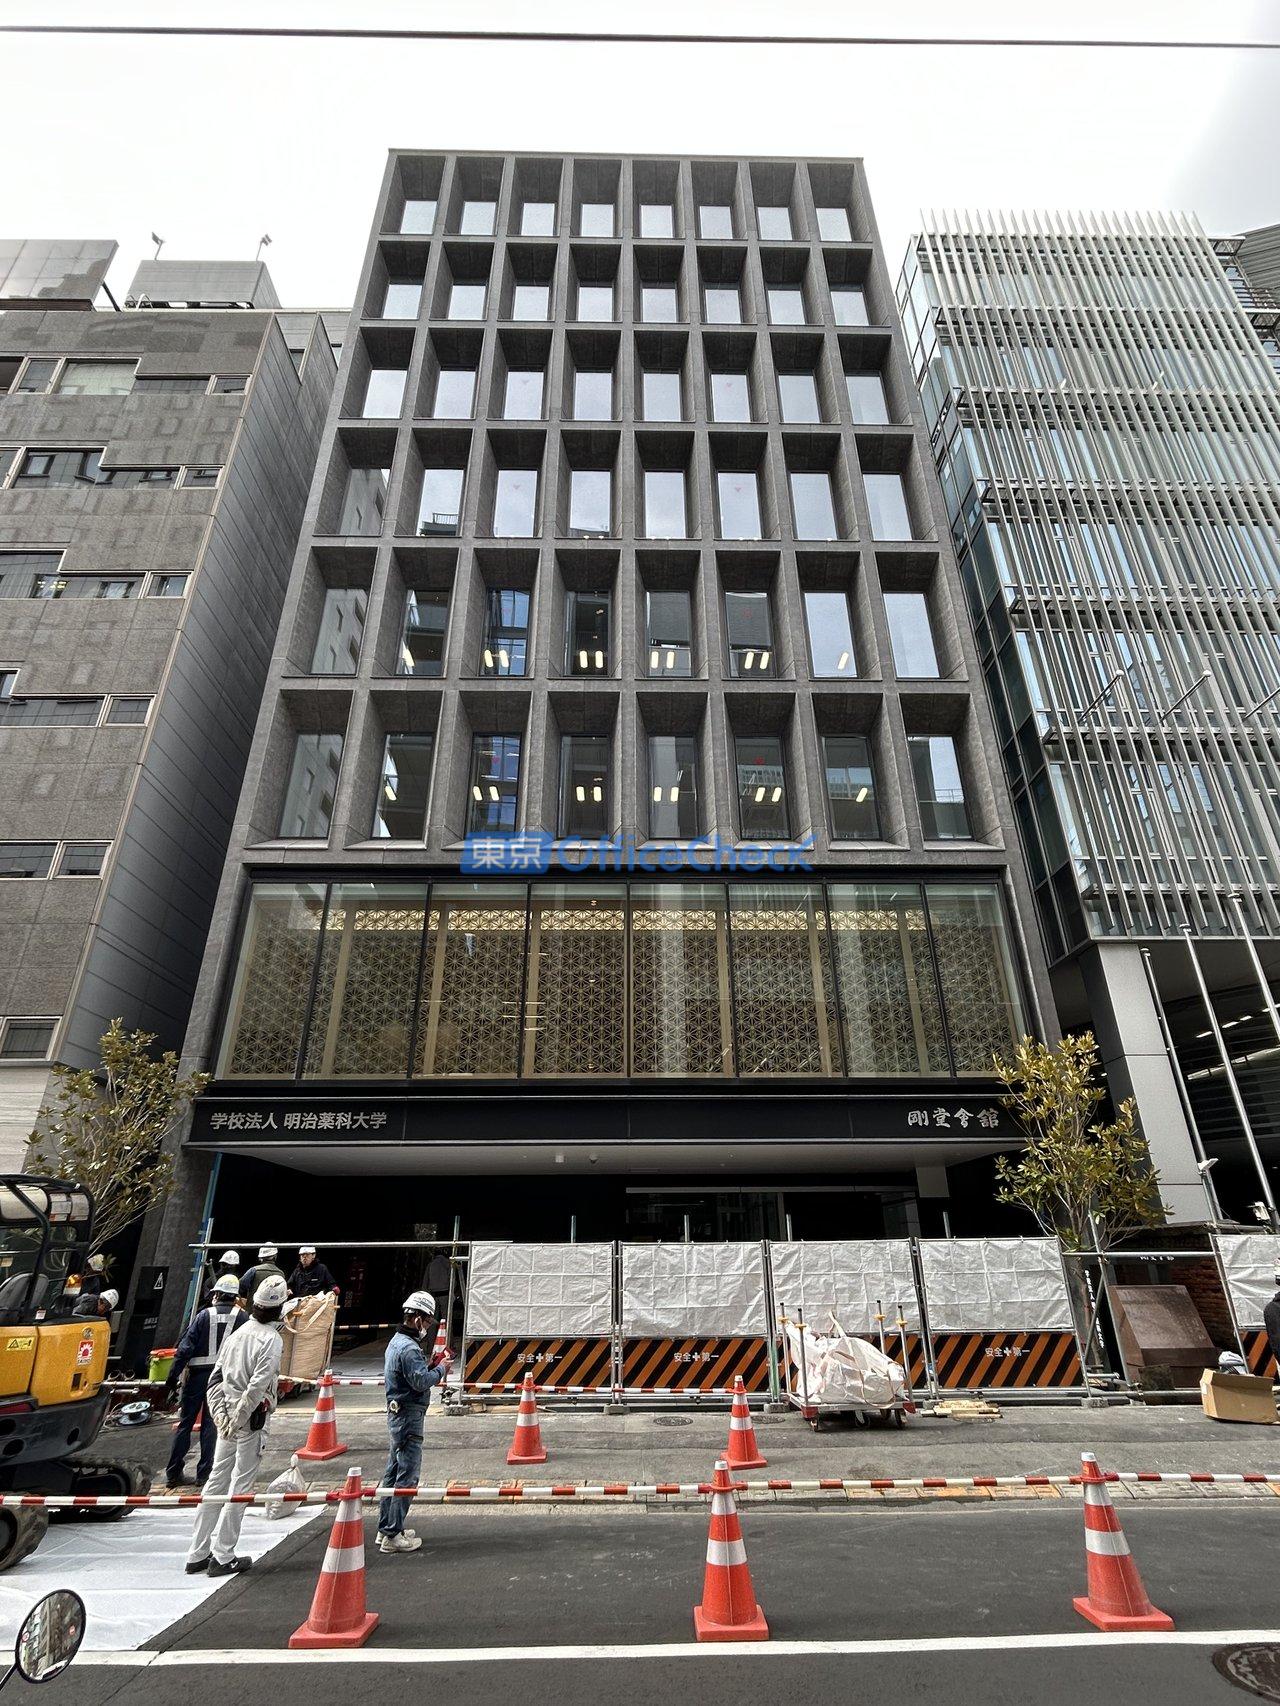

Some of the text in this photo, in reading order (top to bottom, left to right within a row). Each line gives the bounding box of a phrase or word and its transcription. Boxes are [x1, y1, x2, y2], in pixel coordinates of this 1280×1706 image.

[210, 1112, 387, 1130] 学校法人 明治薬科大学
